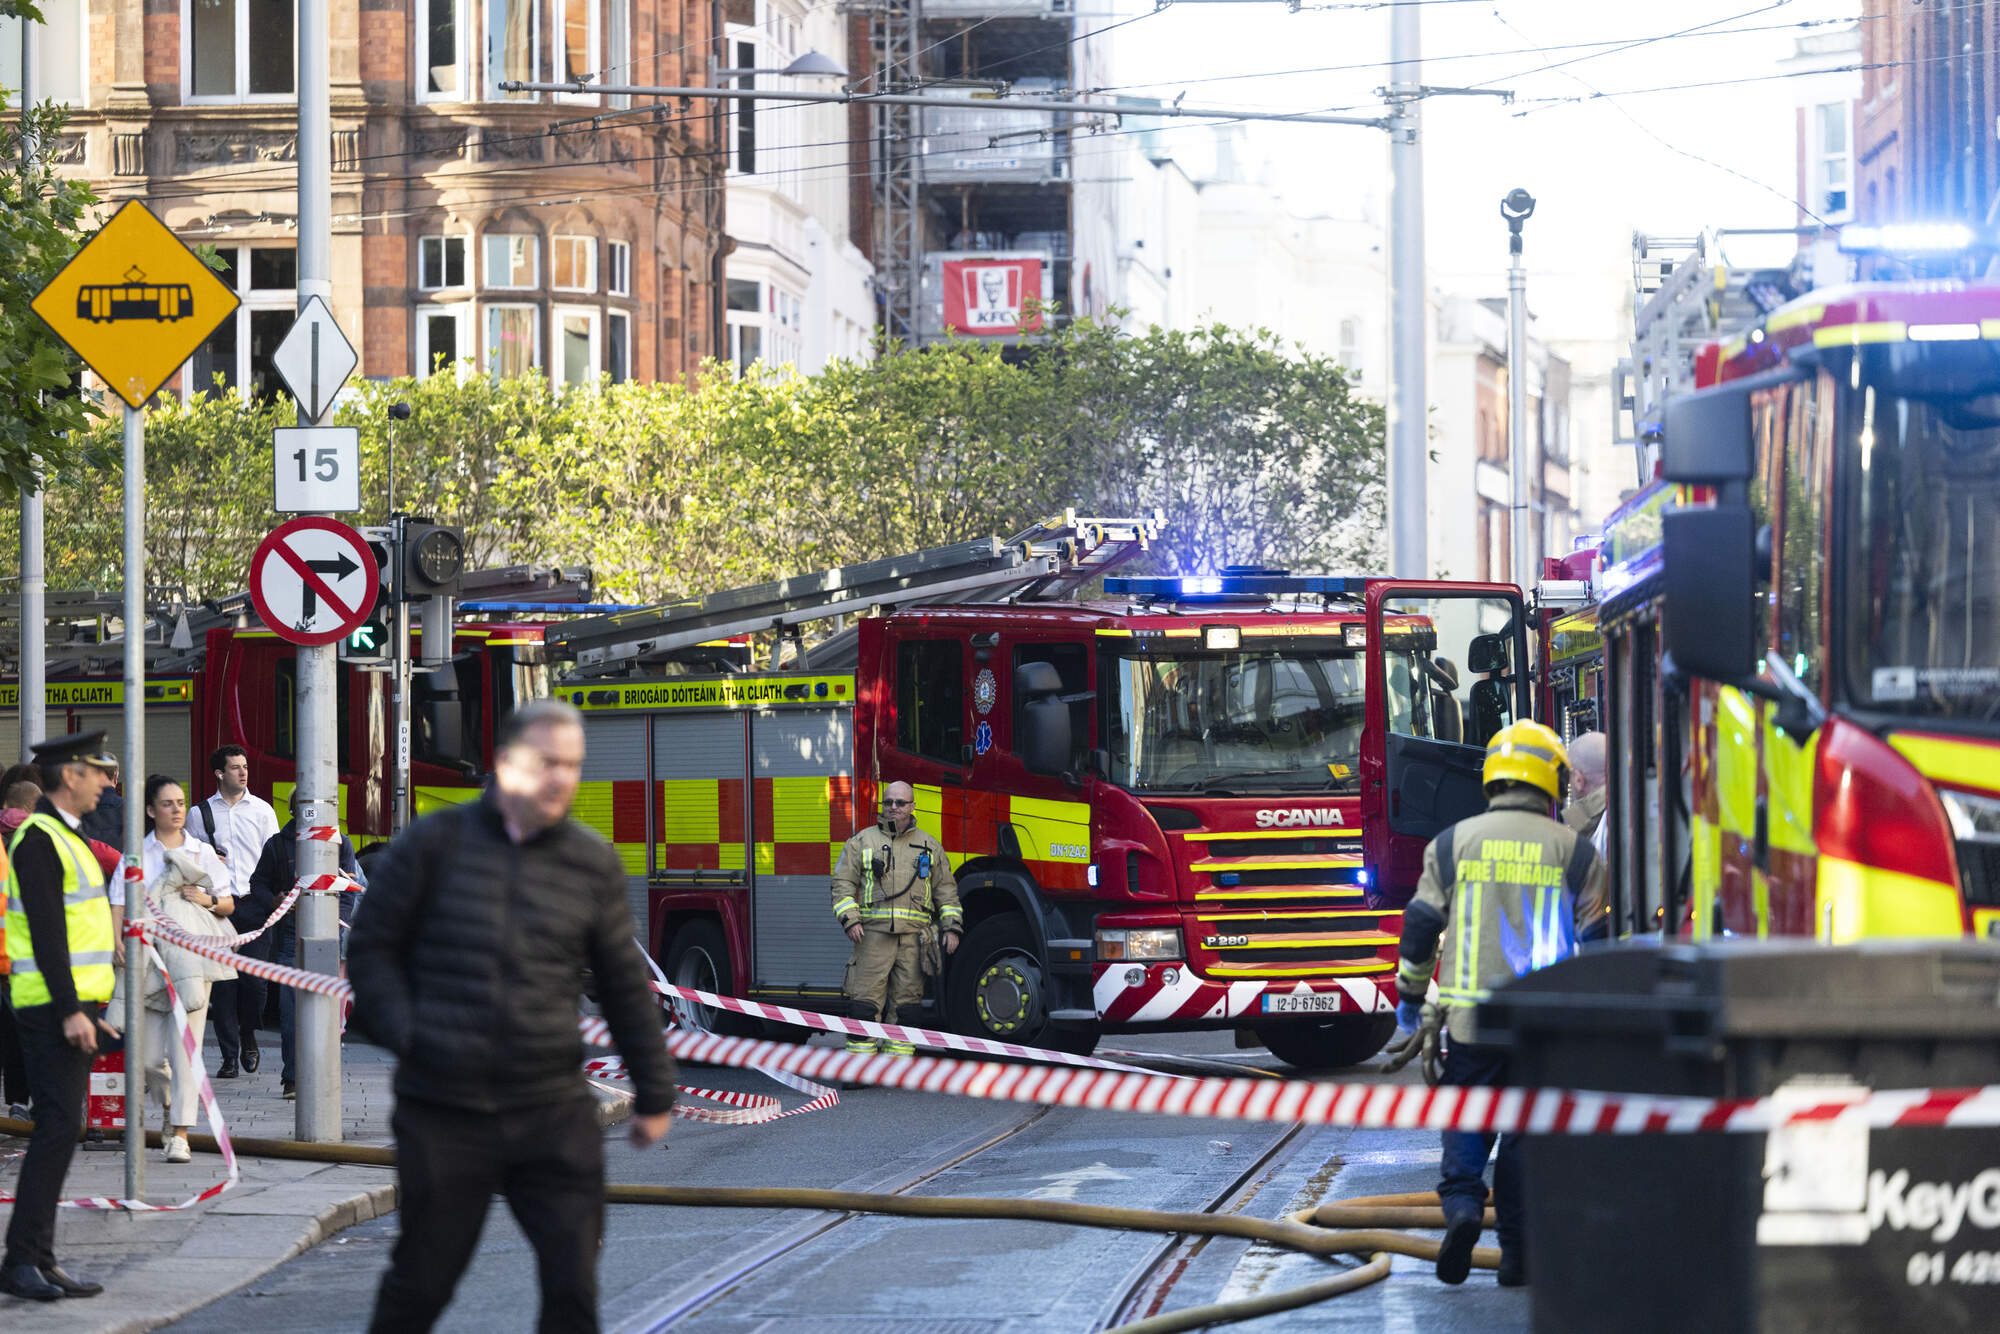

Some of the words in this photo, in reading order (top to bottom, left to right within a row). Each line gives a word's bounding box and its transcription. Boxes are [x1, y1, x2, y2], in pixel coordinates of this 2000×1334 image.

[977, 311, 1012, 323] KFC
[293, 448, 339, 482] 15
[45, 689, 68, 703] THA
[71, 687, 113, 702] CLIATH
[624, 686, 669, 705] BRIOGÁID
[671, 684, 717, 703] DÓITEÁIN
[747, 684, 782, 700] CLIATH
[1255, 808, 1344, 828] SCANIA
[1050, 843, 1088, 858] DN12A2
[1481, 839, 1543, 863] DUBLIN
[1457, 860, 1491, 882] FIRE
[1494, 861, 1564, 887] BRIGADE
[1207, 936, 1217, 946] P
[1218, 935, 1248, 946] 280
[1277, 996, 1335, 1011] 12-D-67962
